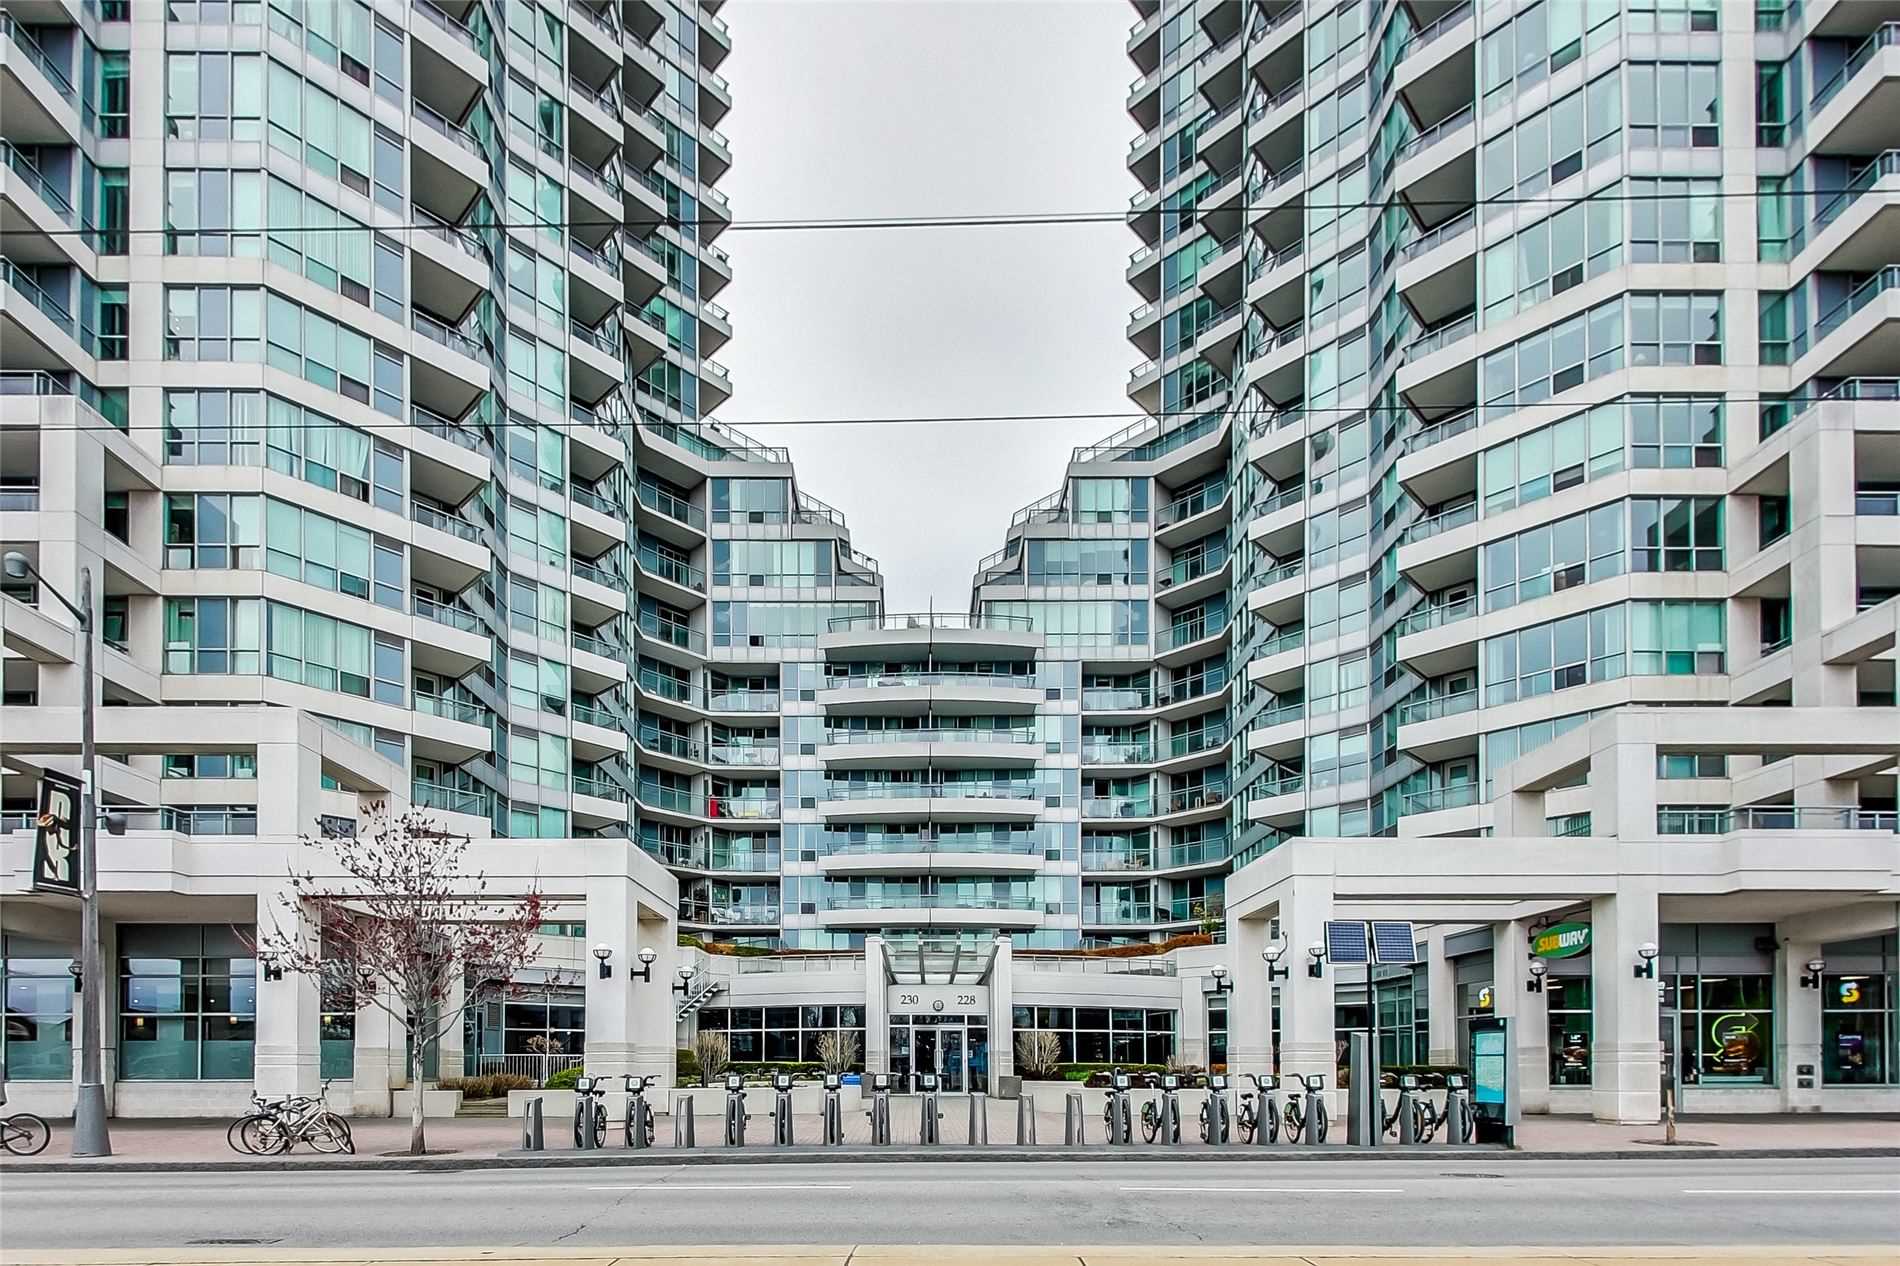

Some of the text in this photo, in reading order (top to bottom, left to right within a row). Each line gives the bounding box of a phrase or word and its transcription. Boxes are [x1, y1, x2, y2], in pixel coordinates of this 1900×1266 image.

[1537, 928, 1589, 953] SUBWAY
[900, 994, 919, 1005] 230
[957, 995, 976, 1005] 228
